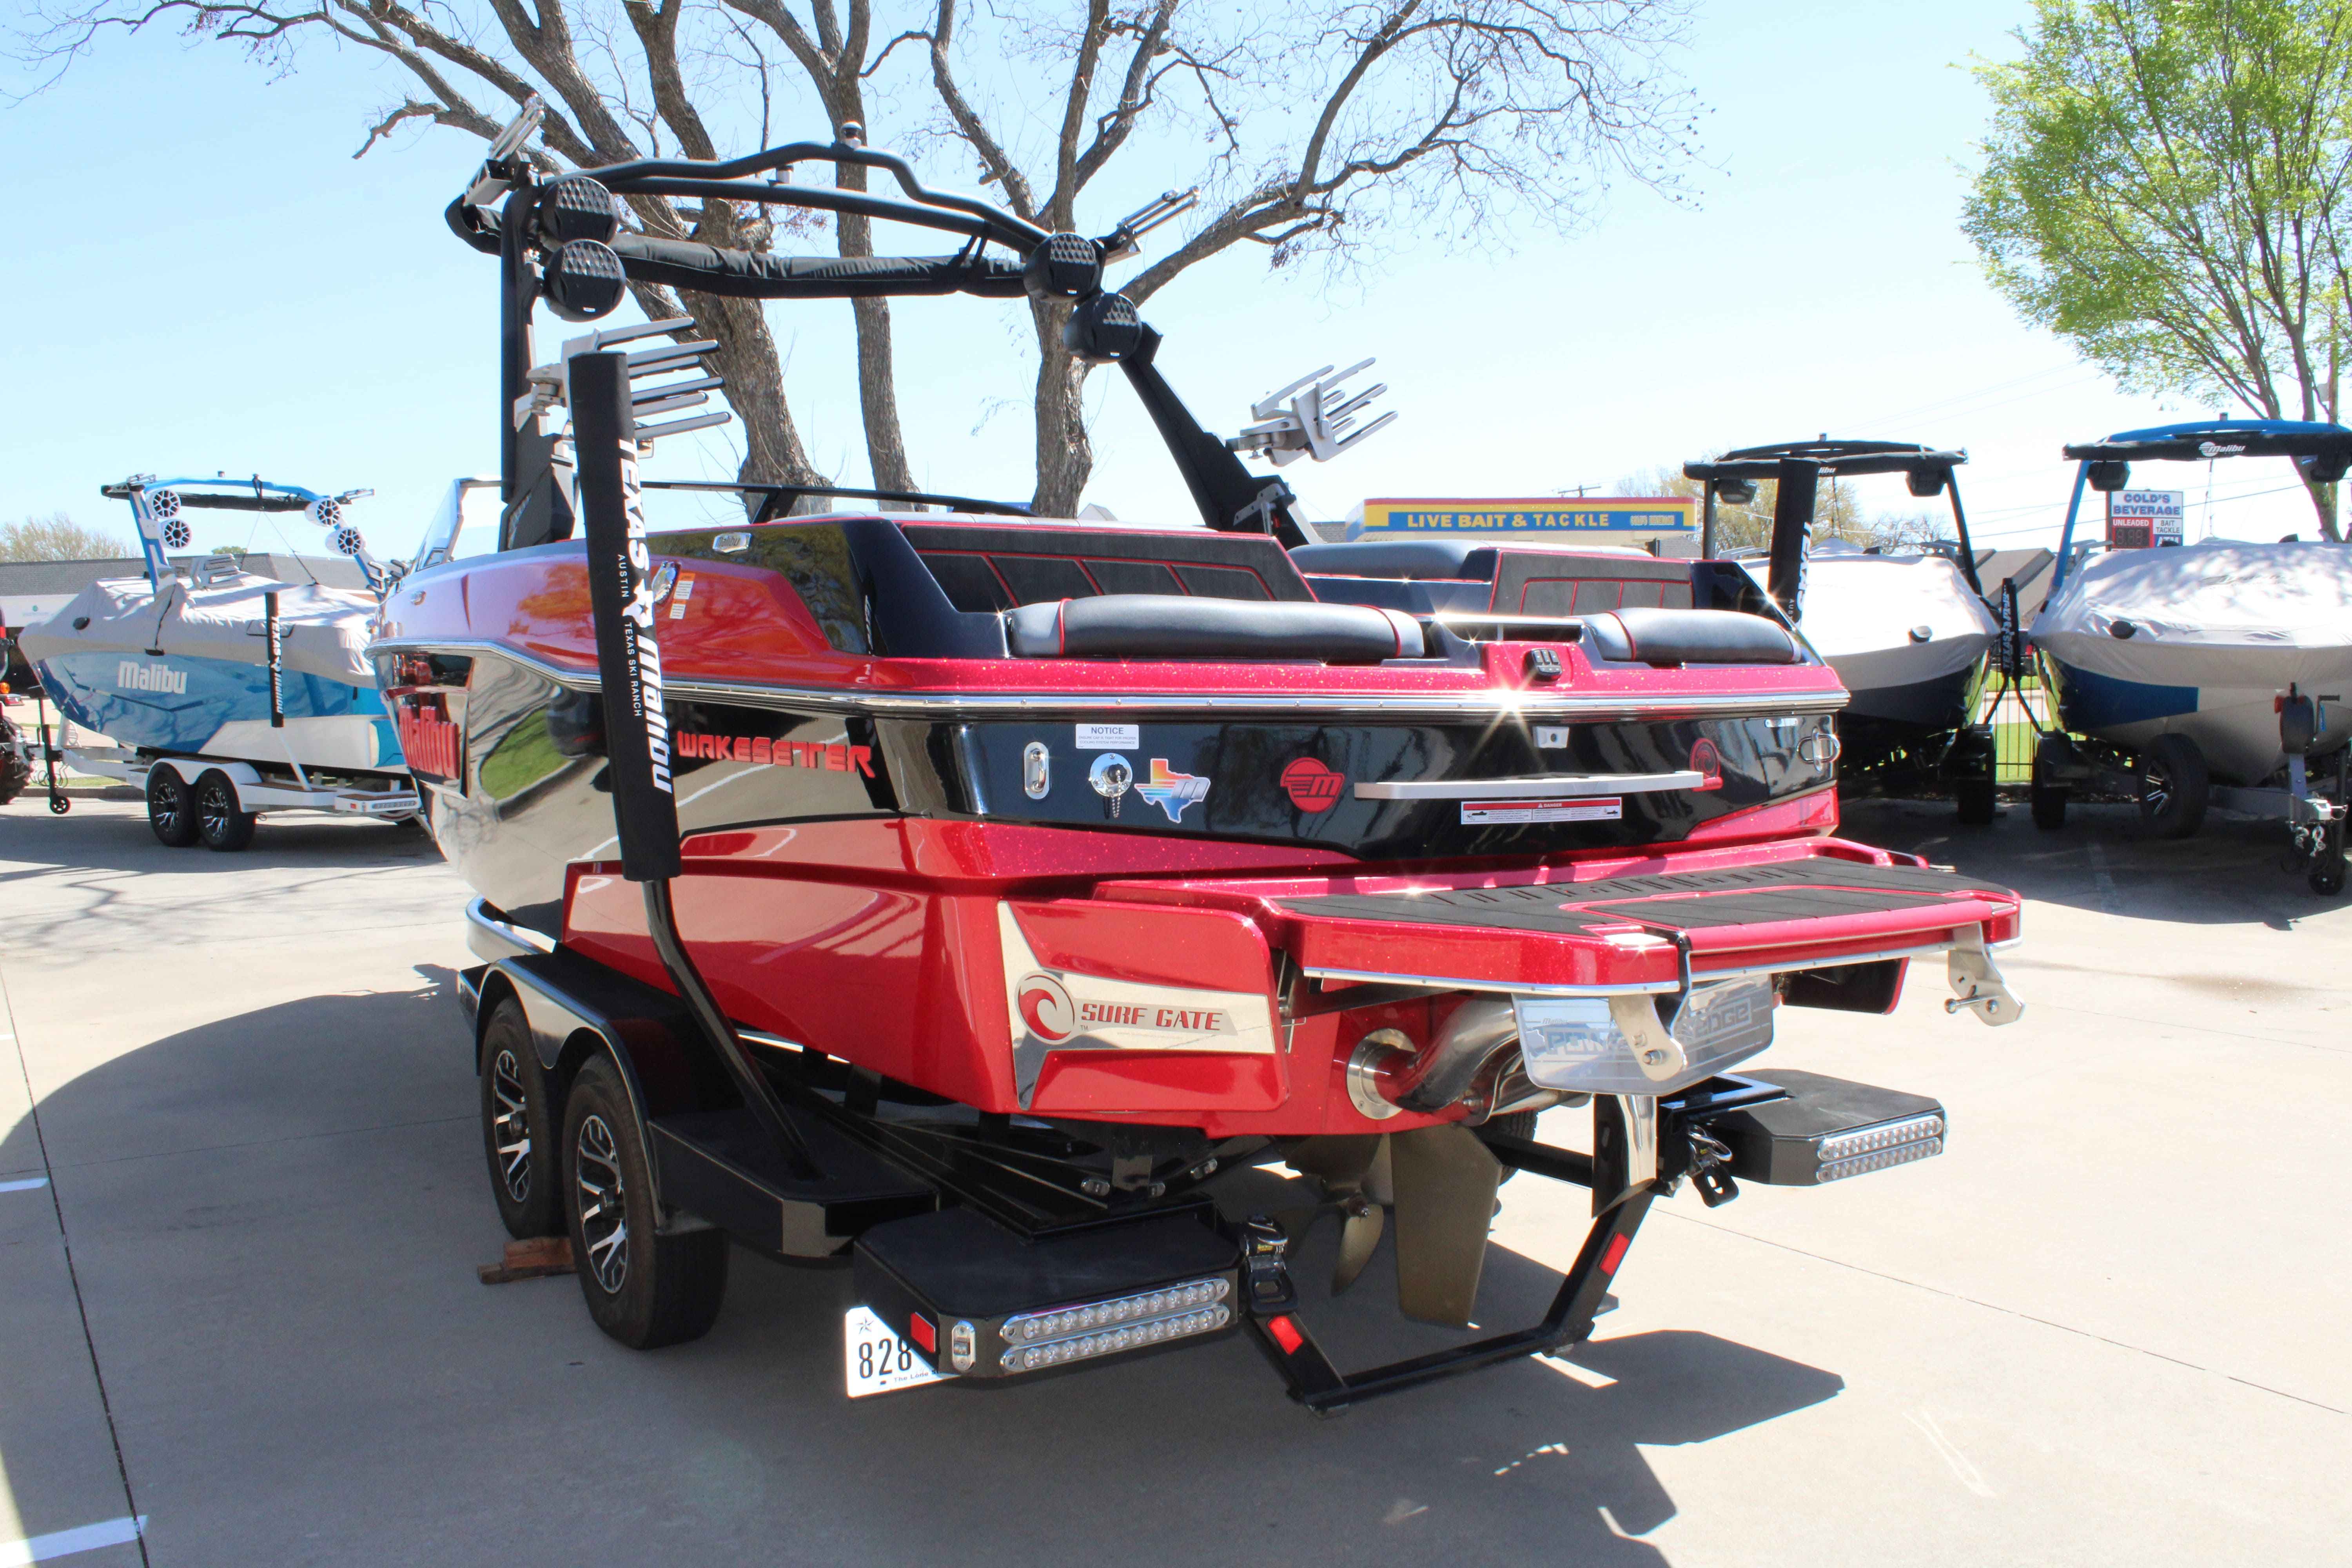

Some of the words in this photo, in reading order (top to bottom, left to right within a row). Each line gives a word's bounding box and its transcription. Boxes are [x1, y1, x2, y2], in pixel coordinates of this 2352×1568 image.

[2209, 444, 2246, 452] Malibu
[619, 438, 650, 571] TEXAS
[2113, 505, 2181, 515] BEVERAGE
[2124, 492, 2171, 503] COLD'S
[1407, 514, 1452, 527] LIVE
[1458, 514, 1506, 527] BAIT
[1512, 514, 1527, 526] &
[1533, 514, 1609, 526] TACKLE
[617, 554, 629, 598] AUSTIN
[1797, 521, 1812, 612] TEXAS
[270, 615, 282, 656] TEXAS
[624, 622, 635, 655] TEXAS
[118, 661, 188, 694] Malibu
[628, 660, 636, 677] SKI
[630, 680, 642, 717] RANCH
[636, 634, 673, 794] Malibu
[398, 705, 460, 779] Malibu
[677, 730, 876, 779] WAKESETTER
[1081, 1002, 1148, 1025] SURF
[1156, 1009, 1223, 1031] GATE
[859, 1337, 912, 1379] 828
